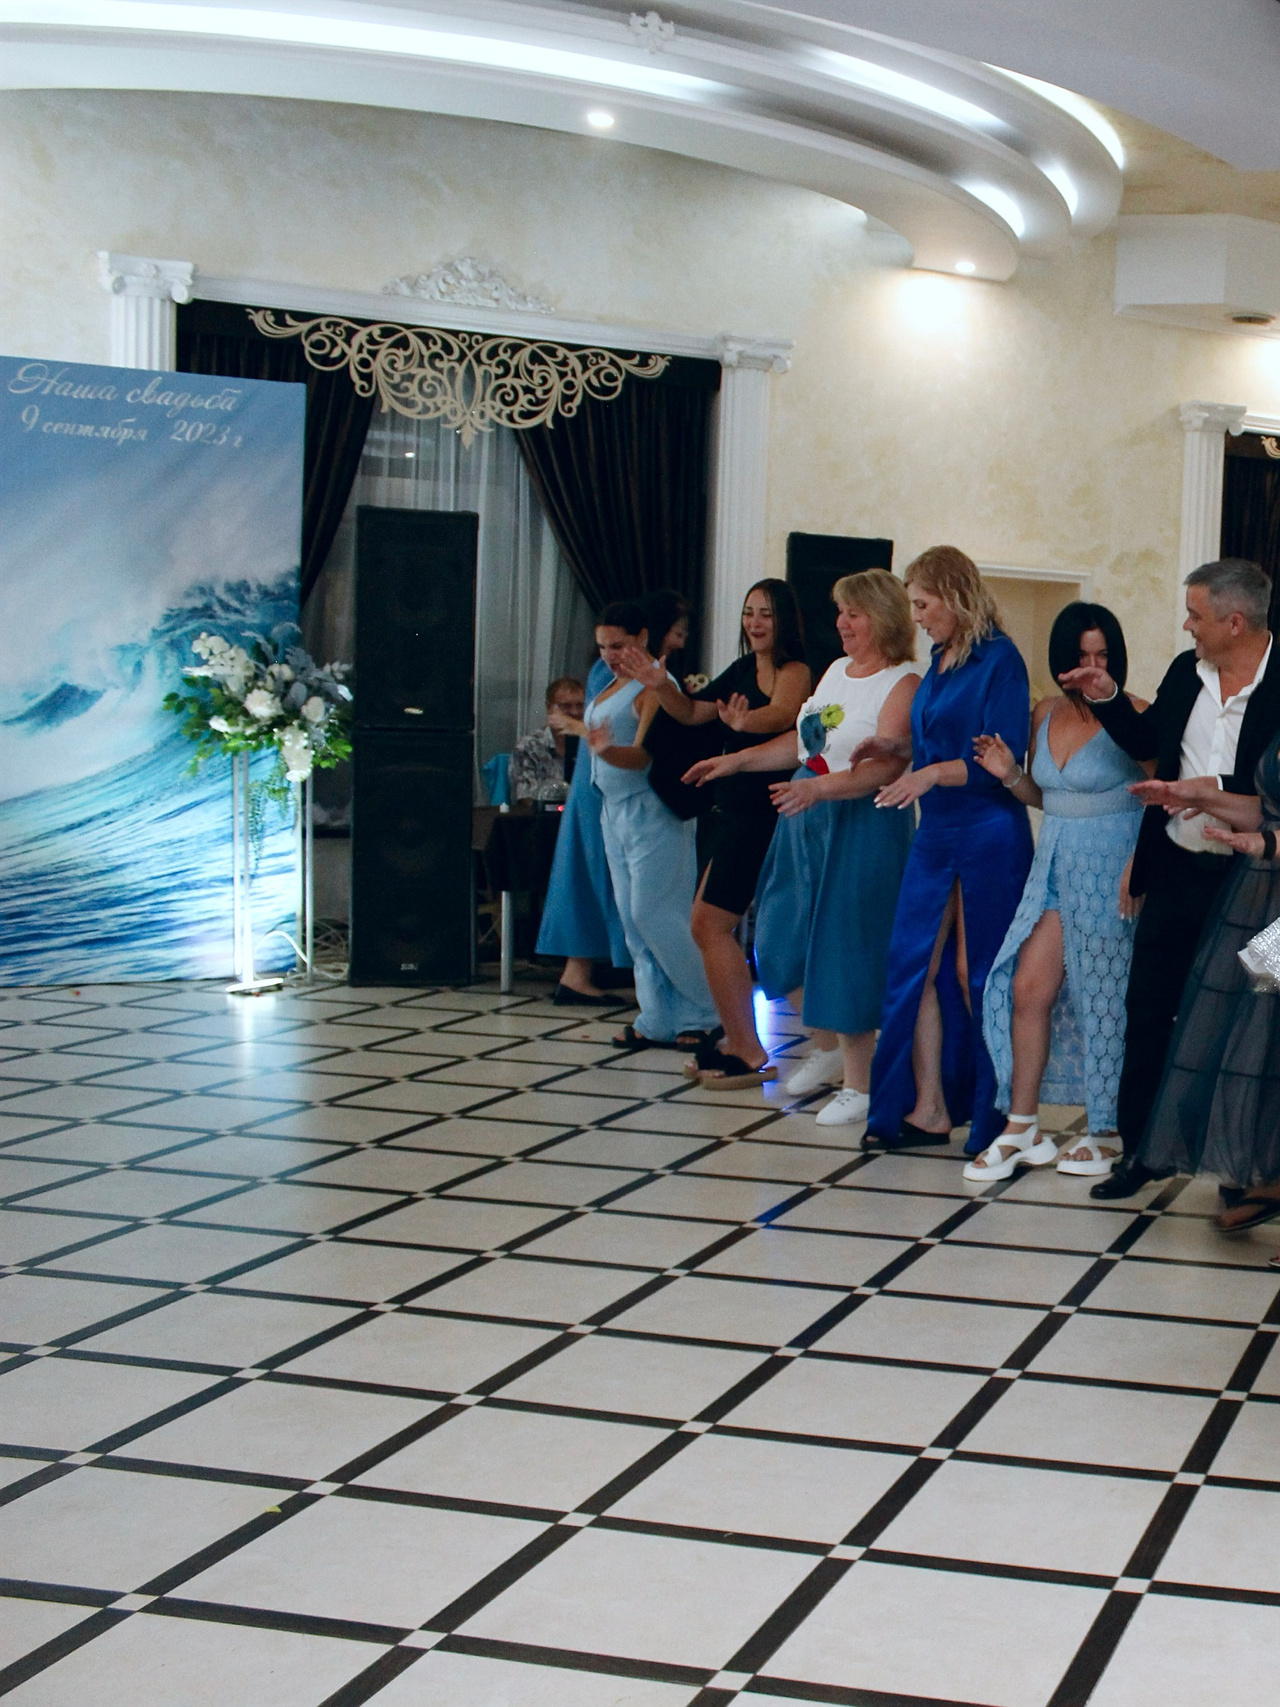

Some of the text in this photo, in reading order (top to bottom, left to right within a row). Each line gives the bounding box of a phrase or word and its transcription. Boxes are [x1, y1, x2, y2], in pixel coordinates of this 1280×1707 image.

[8, 362, 242, 418] Наша свадьба
[21, 404, 40, 433] 9
[42, 418, 148, 445] сентября
[169, 419, 231, 447] 2023
